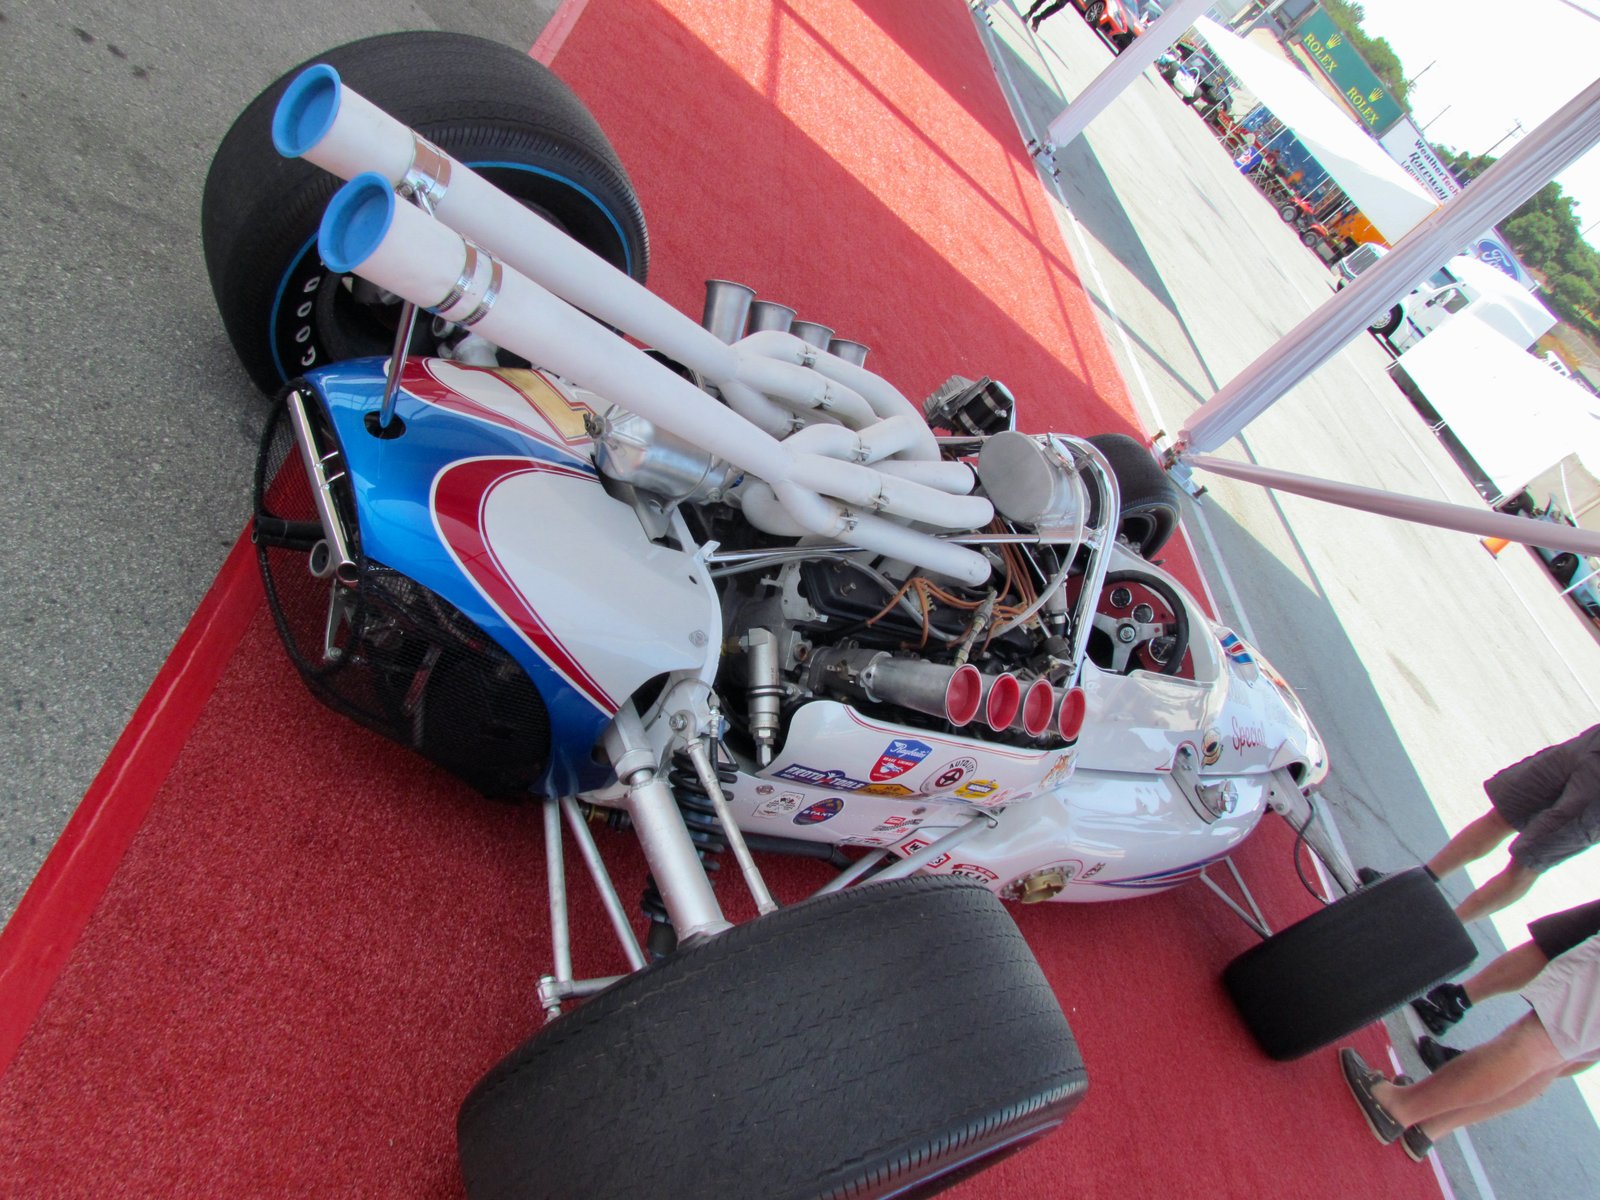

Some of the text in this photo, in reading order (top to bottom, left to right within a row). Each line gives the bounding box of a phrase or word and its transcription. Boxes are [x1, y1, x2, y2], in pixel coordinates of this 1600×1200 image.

[1304, 33, 1338, 73] ROLEX
[1346, 86, 1380, 126] ROLEX
[1408, 151, 1449, 202] Raceway
[1413, 139, 1459, 196] WeatherTech
[1231, 715, 1265, 756] Special
[785, 766, 827, 781] PROTO
[830, 778, 866, 789] TOOLS
[948, 759, 975, 774] AUTOLITE
